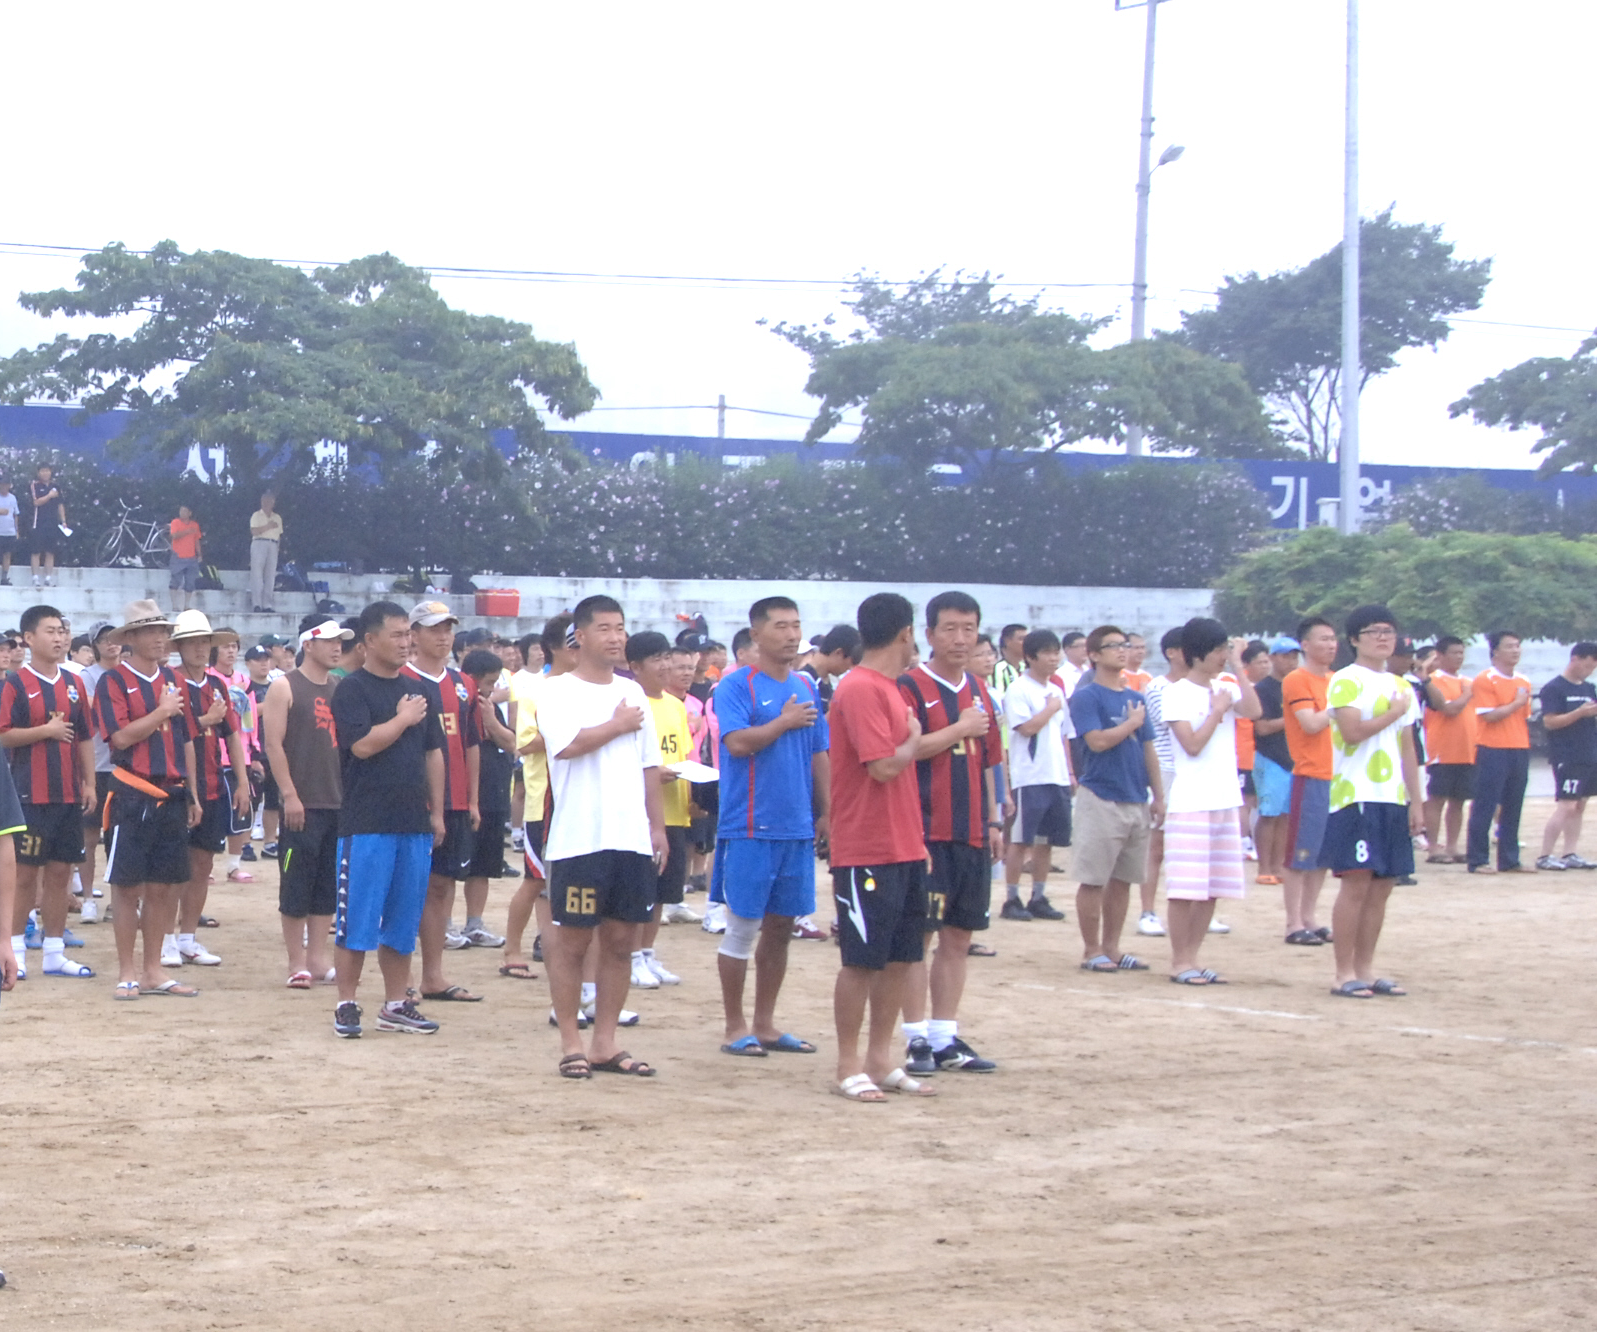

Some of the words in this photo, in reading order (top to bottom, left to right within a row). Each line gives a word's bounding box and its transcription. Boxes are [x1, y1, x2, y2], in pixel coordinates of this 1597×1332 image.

[660, 733, 678, 755] 45
[1562, 779, 1580, 794] 47
[20, 833, 42, 856] 31
[1355, 839, 1370, 863] 8
[565, 886, 597, 915] 66
